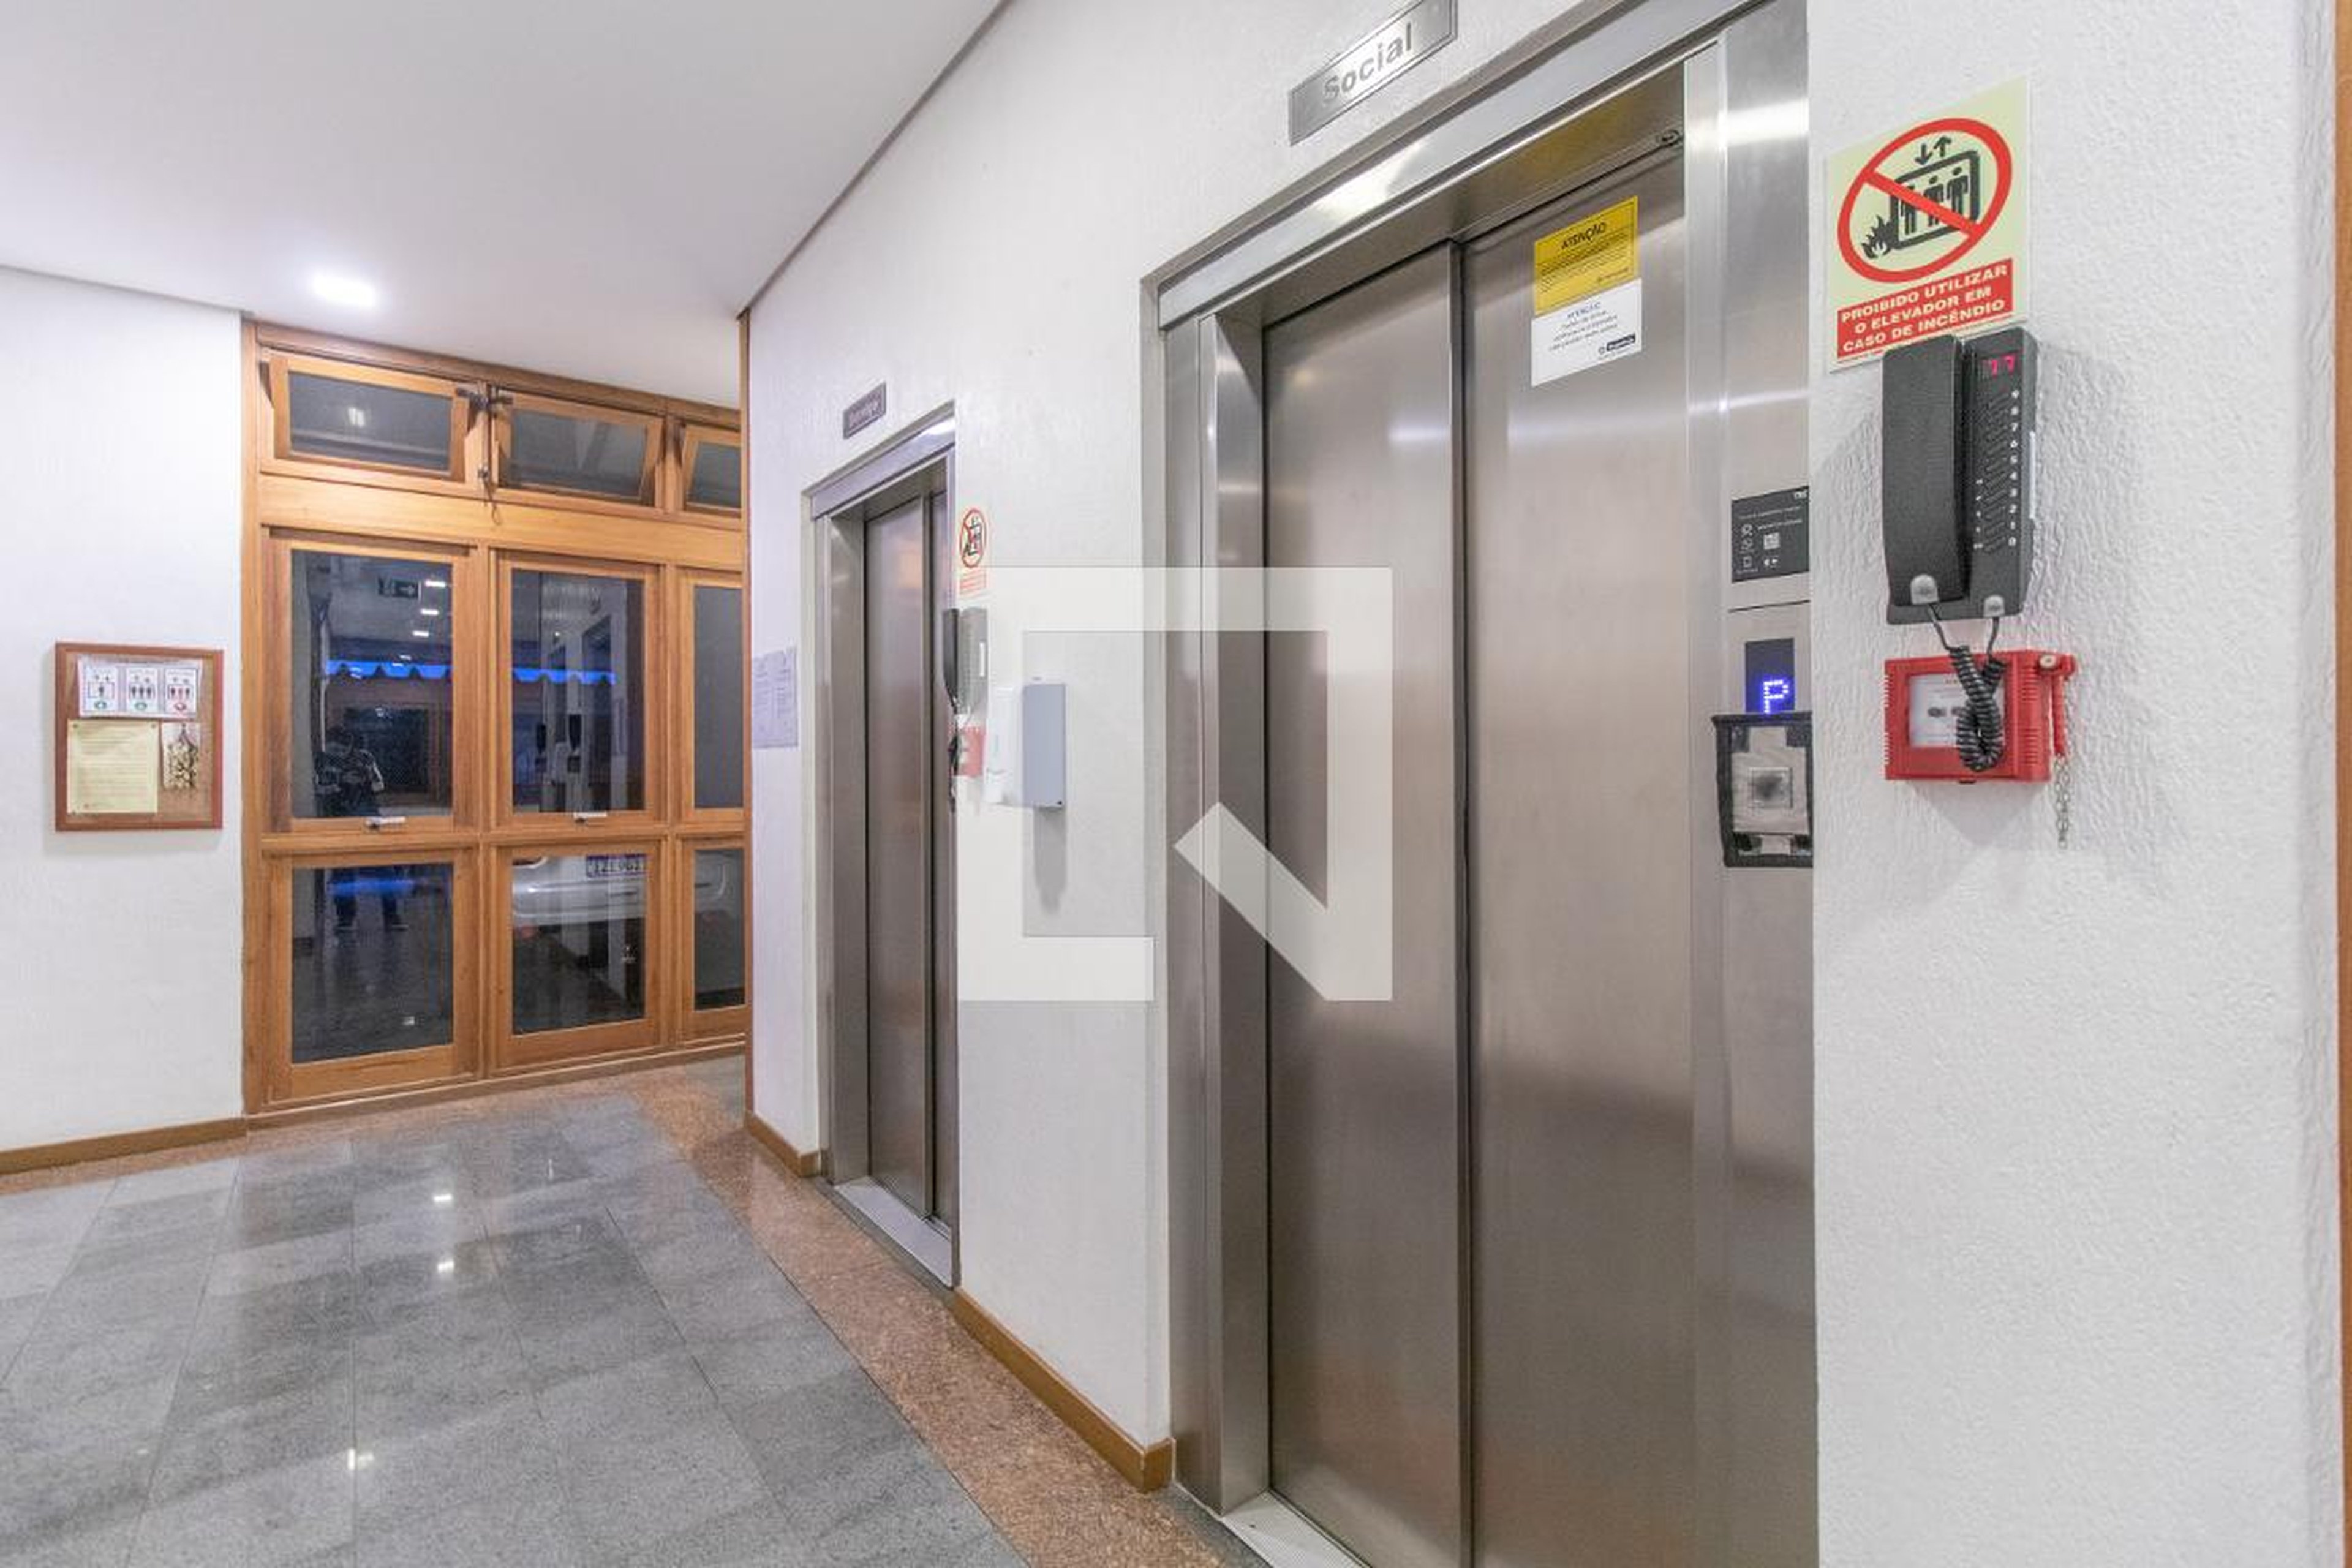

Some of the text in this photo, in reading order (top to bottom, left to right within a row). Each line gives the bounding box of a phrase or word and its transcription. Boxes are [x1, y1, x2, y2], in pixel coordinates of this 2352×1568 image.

[1323, 22, 1411, 103] Social
[1841, 265, 2008, 323] PROIBIDO UTILIZAR
[1855, 287, 1991, 334] O ELEVADOR EM
[1843, 299, 2005, 352] CASO DE INCÊNDIO
[1763, 679, 1789, 714] P
